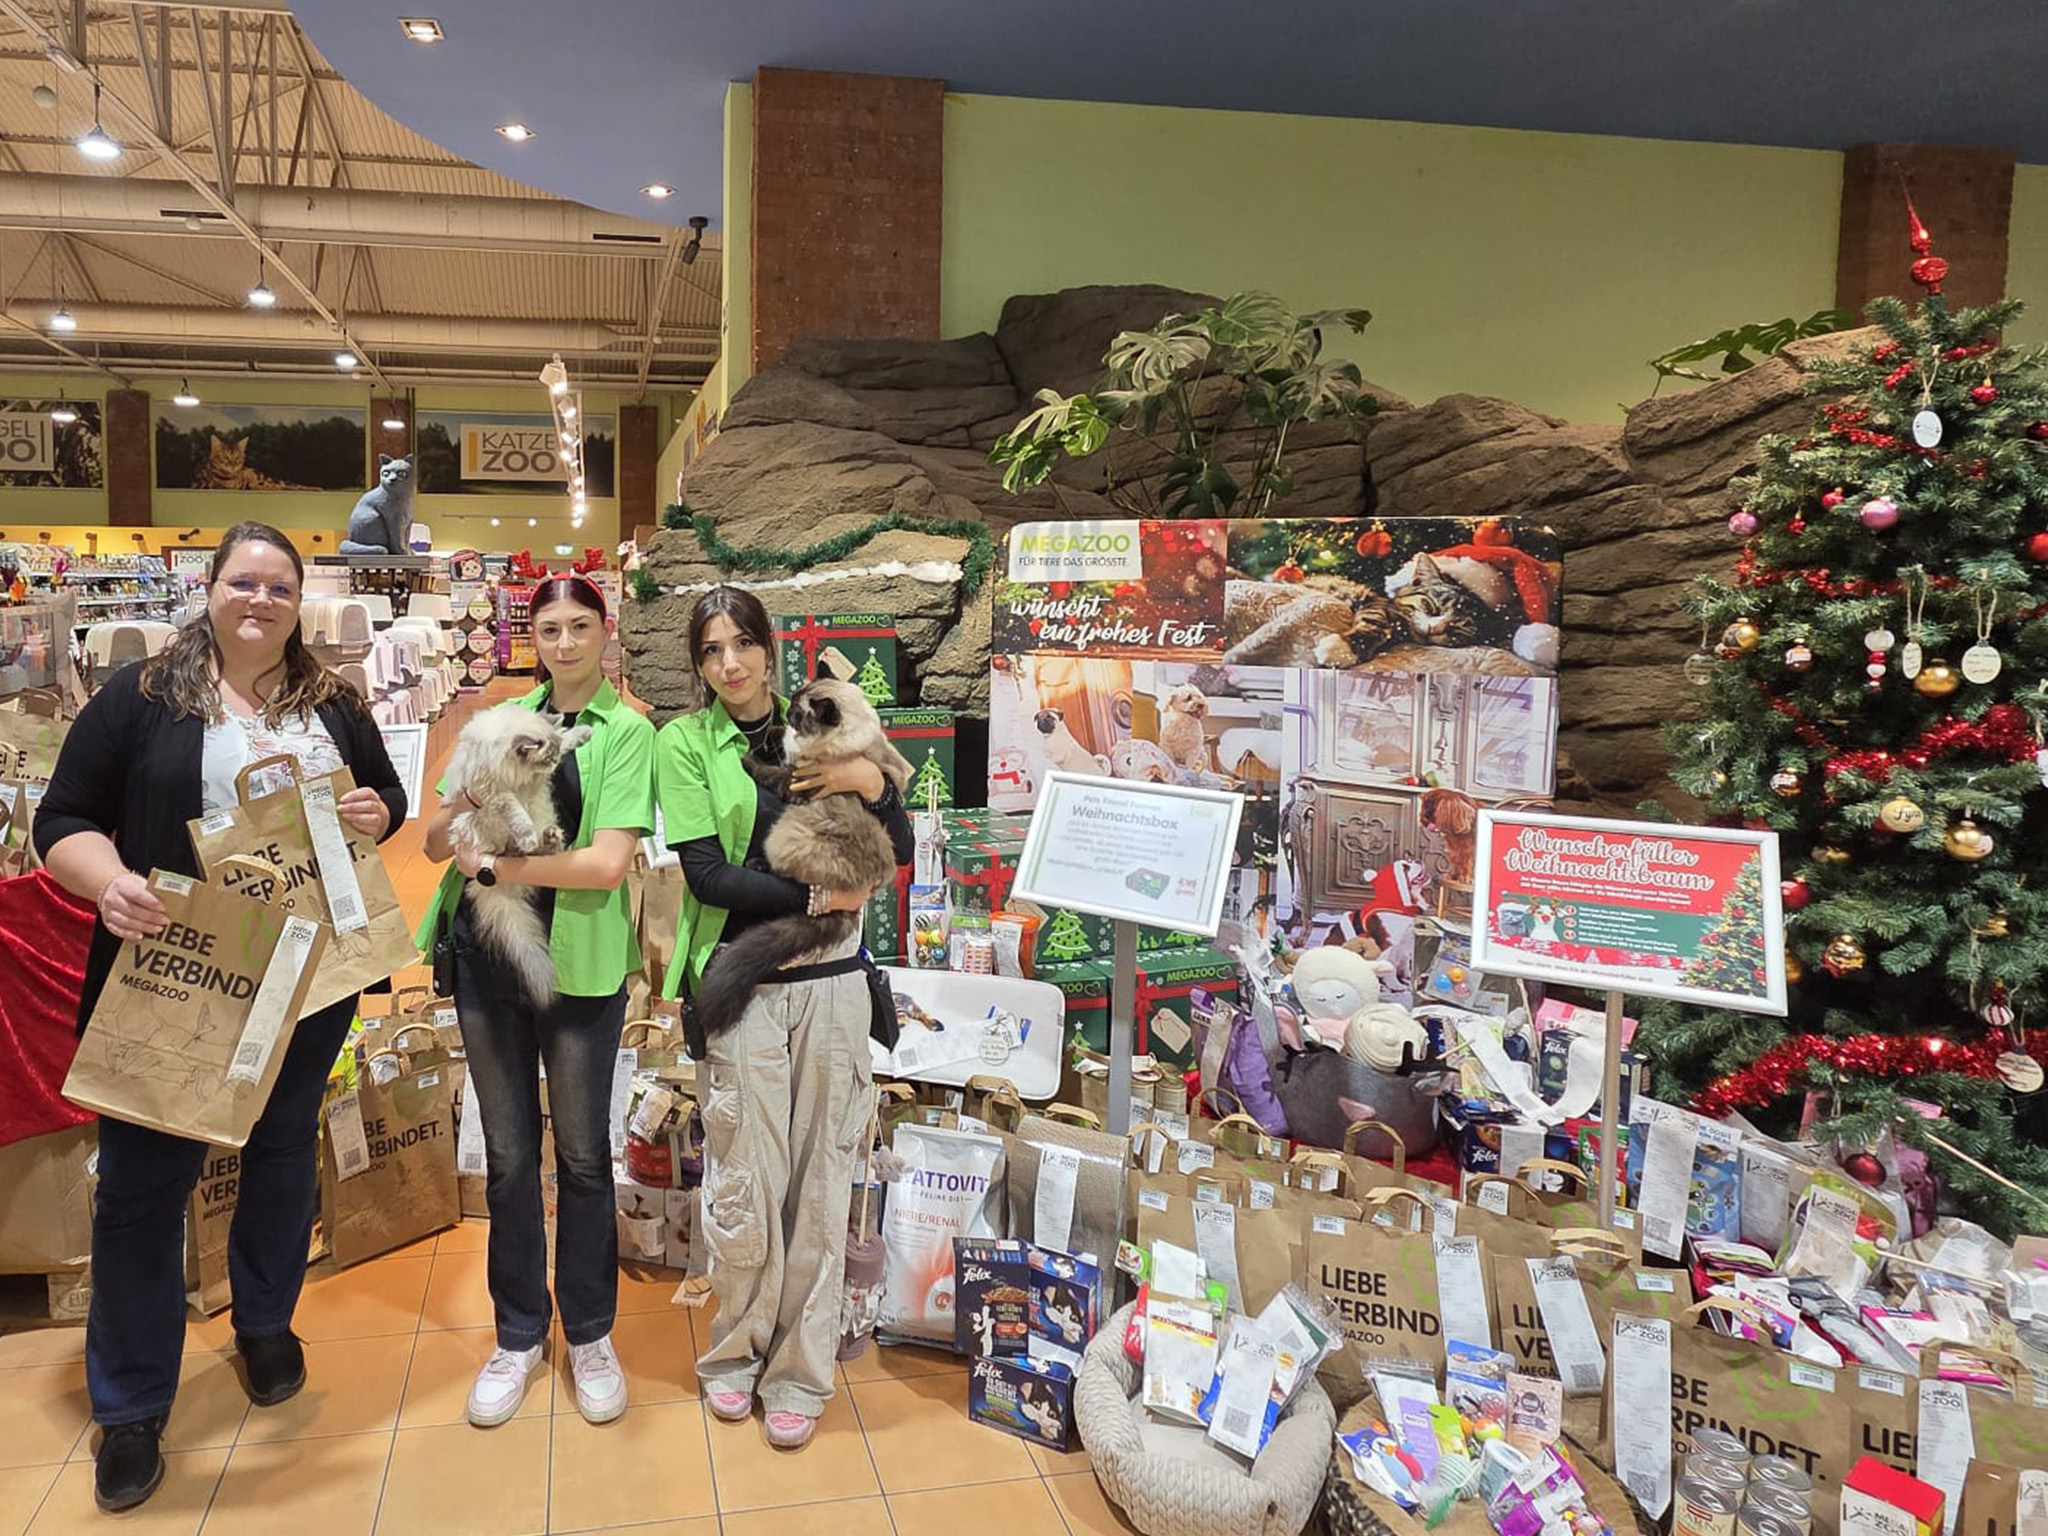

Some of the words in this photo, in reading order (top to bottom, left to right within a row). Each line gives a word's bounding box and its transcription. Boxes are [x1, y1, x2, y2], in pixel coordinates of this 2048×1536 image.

[482, 450, 556, 473] ZOO
[1020, 534, 1130, 552] MEGAZOO
[1063, 557, 1082, 566] DAS
[1039, 621, 1078, 641] ein
[1076, 619, 1153, 650] frohes
[1157, 619, 1216, 646] Fest
[1072, 804, 1179, 830] Weihnachtsbox
[1517, 827, 1699, 868] Wunscherfüller
[1504, 849, 1715, 891] Weihnachtsbaum
[120, 974, 190, 1002] MEGAZOO
[1471, 1149, 1500, 1164] felix
[962, 1265, 992, 1285] felix
[1321, 1264, 1387, 1297] LIEBE
[1332, 1296, 1440, 1337] ERBIND
[973, 1361, 1003, 1379] felix
